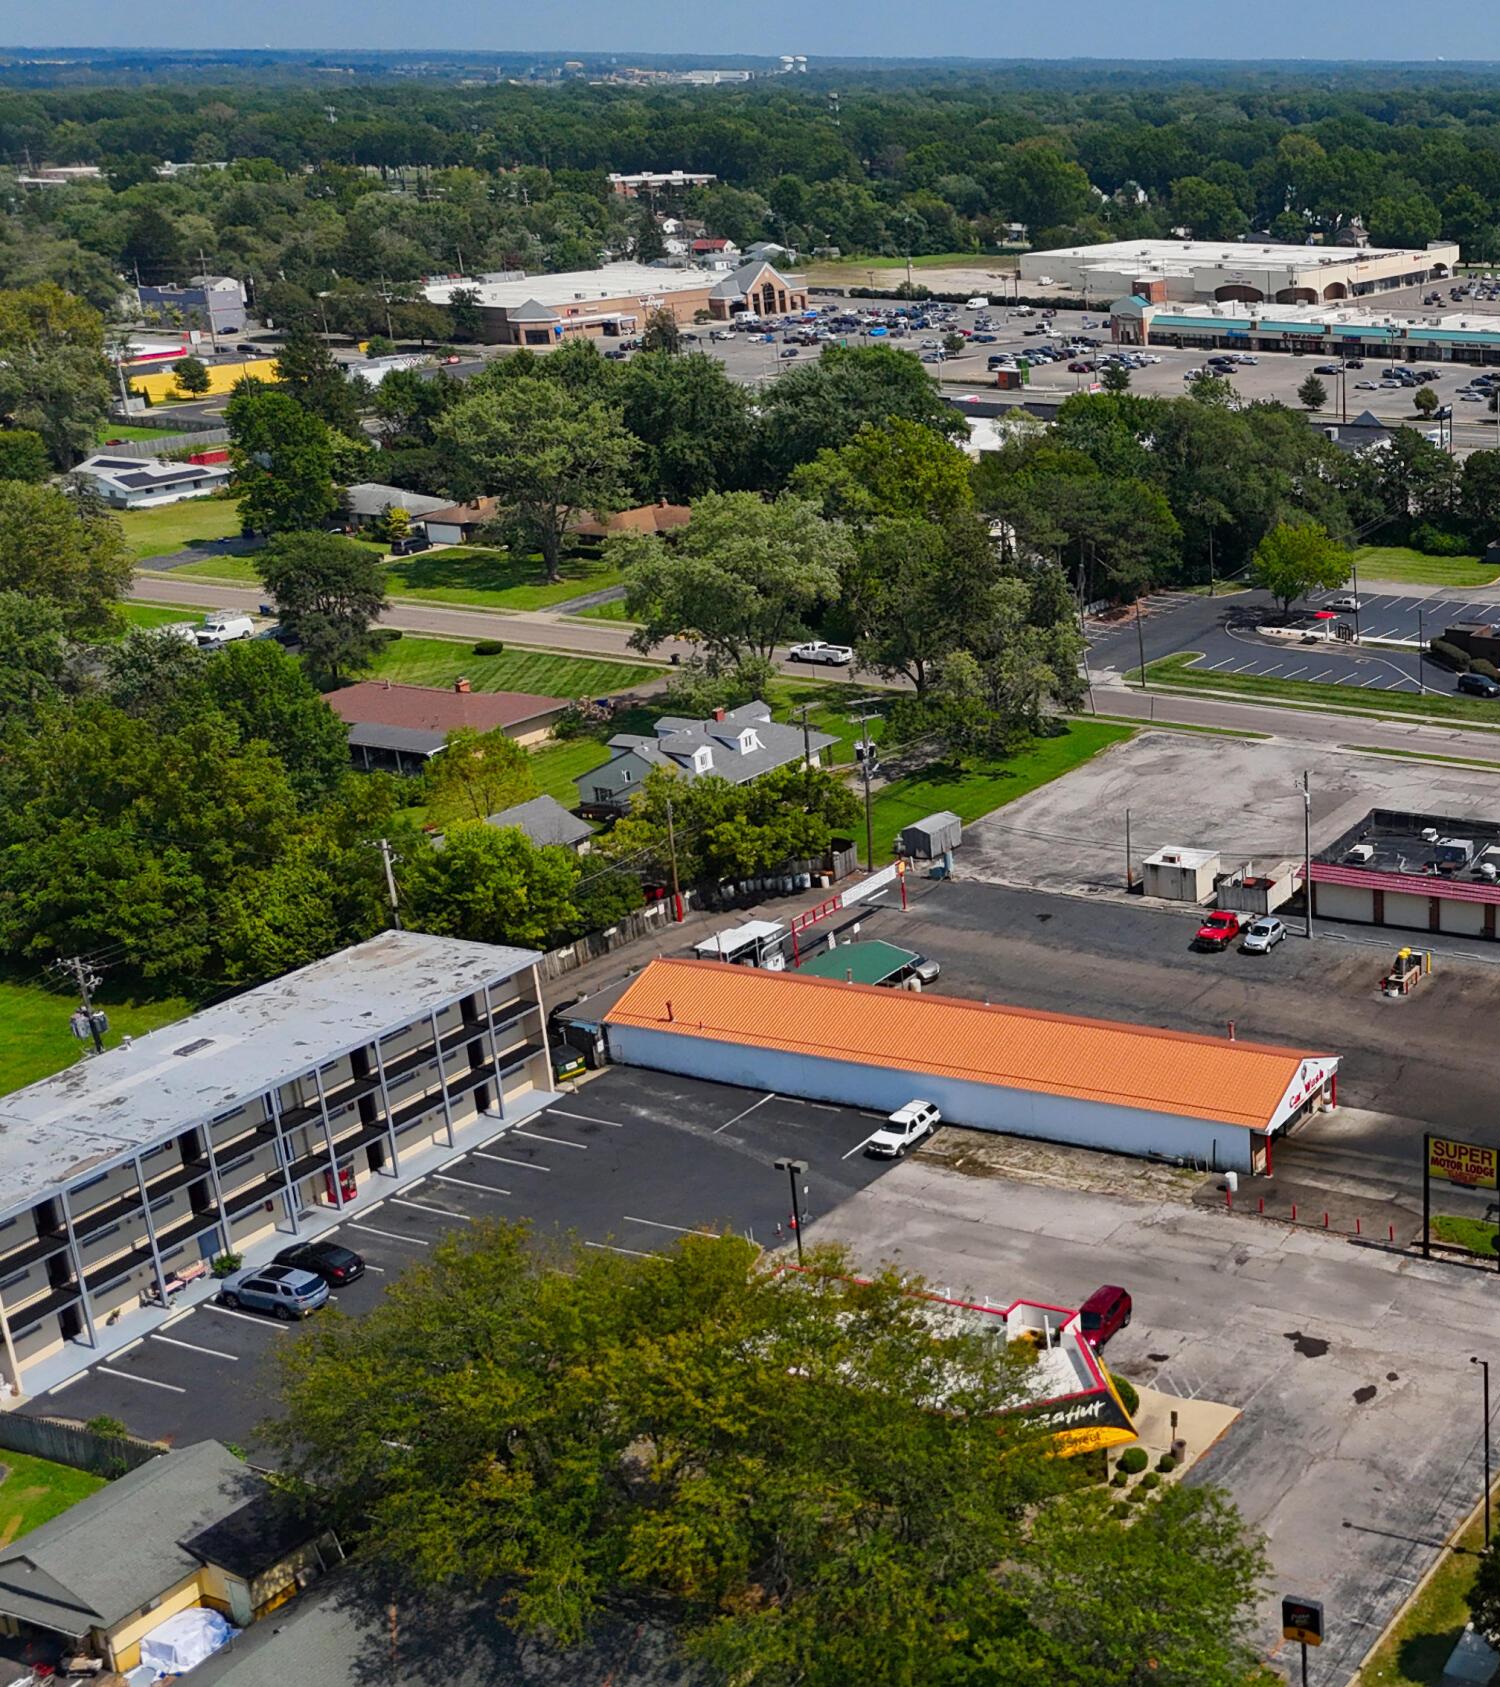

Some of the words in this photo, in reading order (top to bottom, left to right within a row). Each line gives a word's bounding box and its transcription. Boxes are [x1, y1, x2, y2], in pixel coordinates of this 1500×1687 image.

[1433, 1140, 1494, 1167] SUPER
[1430, 1156, 1464, 1172] MOTOR
[1465, 1162, 1496, 1178] LODGE
[1064, 1400, 1107, 1425] Hut
